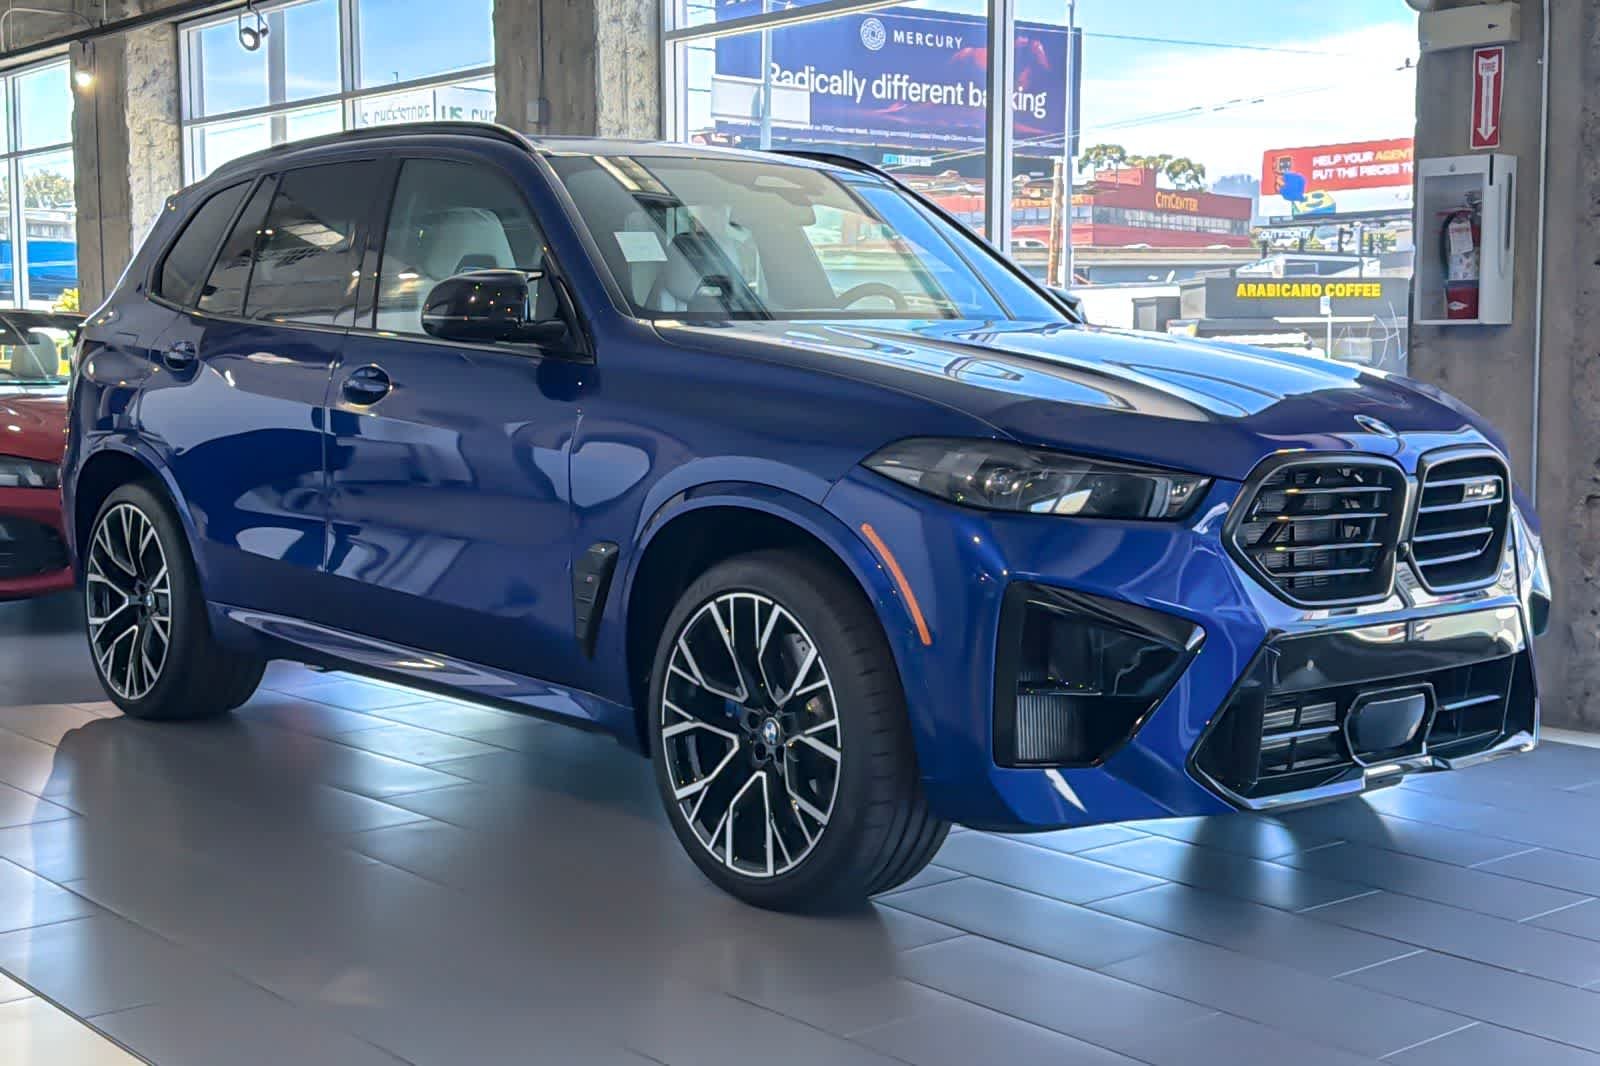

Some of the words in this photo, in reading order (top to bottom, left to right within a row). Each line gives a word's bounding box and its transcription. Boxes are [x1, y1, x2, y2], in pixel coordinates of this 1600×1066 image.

[893, 29, 963, 49] MERCURY
[1480, 62, 1497, 72] FIRE
[769, 62, 867, 103] Radically
[871, 73, 964, 106] different
[1312, 155, 1342, 167] HELP
[1343, 151, 1375, 164] YOUR
[1312, 168, 1336, 180] PUT
[1336, 166, 1358, 179] THE
[1359, 163, 1399, 176] PIECES
[1236, 283, 1321, 297] ARABICANO
[1325, 283, 1381, 297] COFFEE
